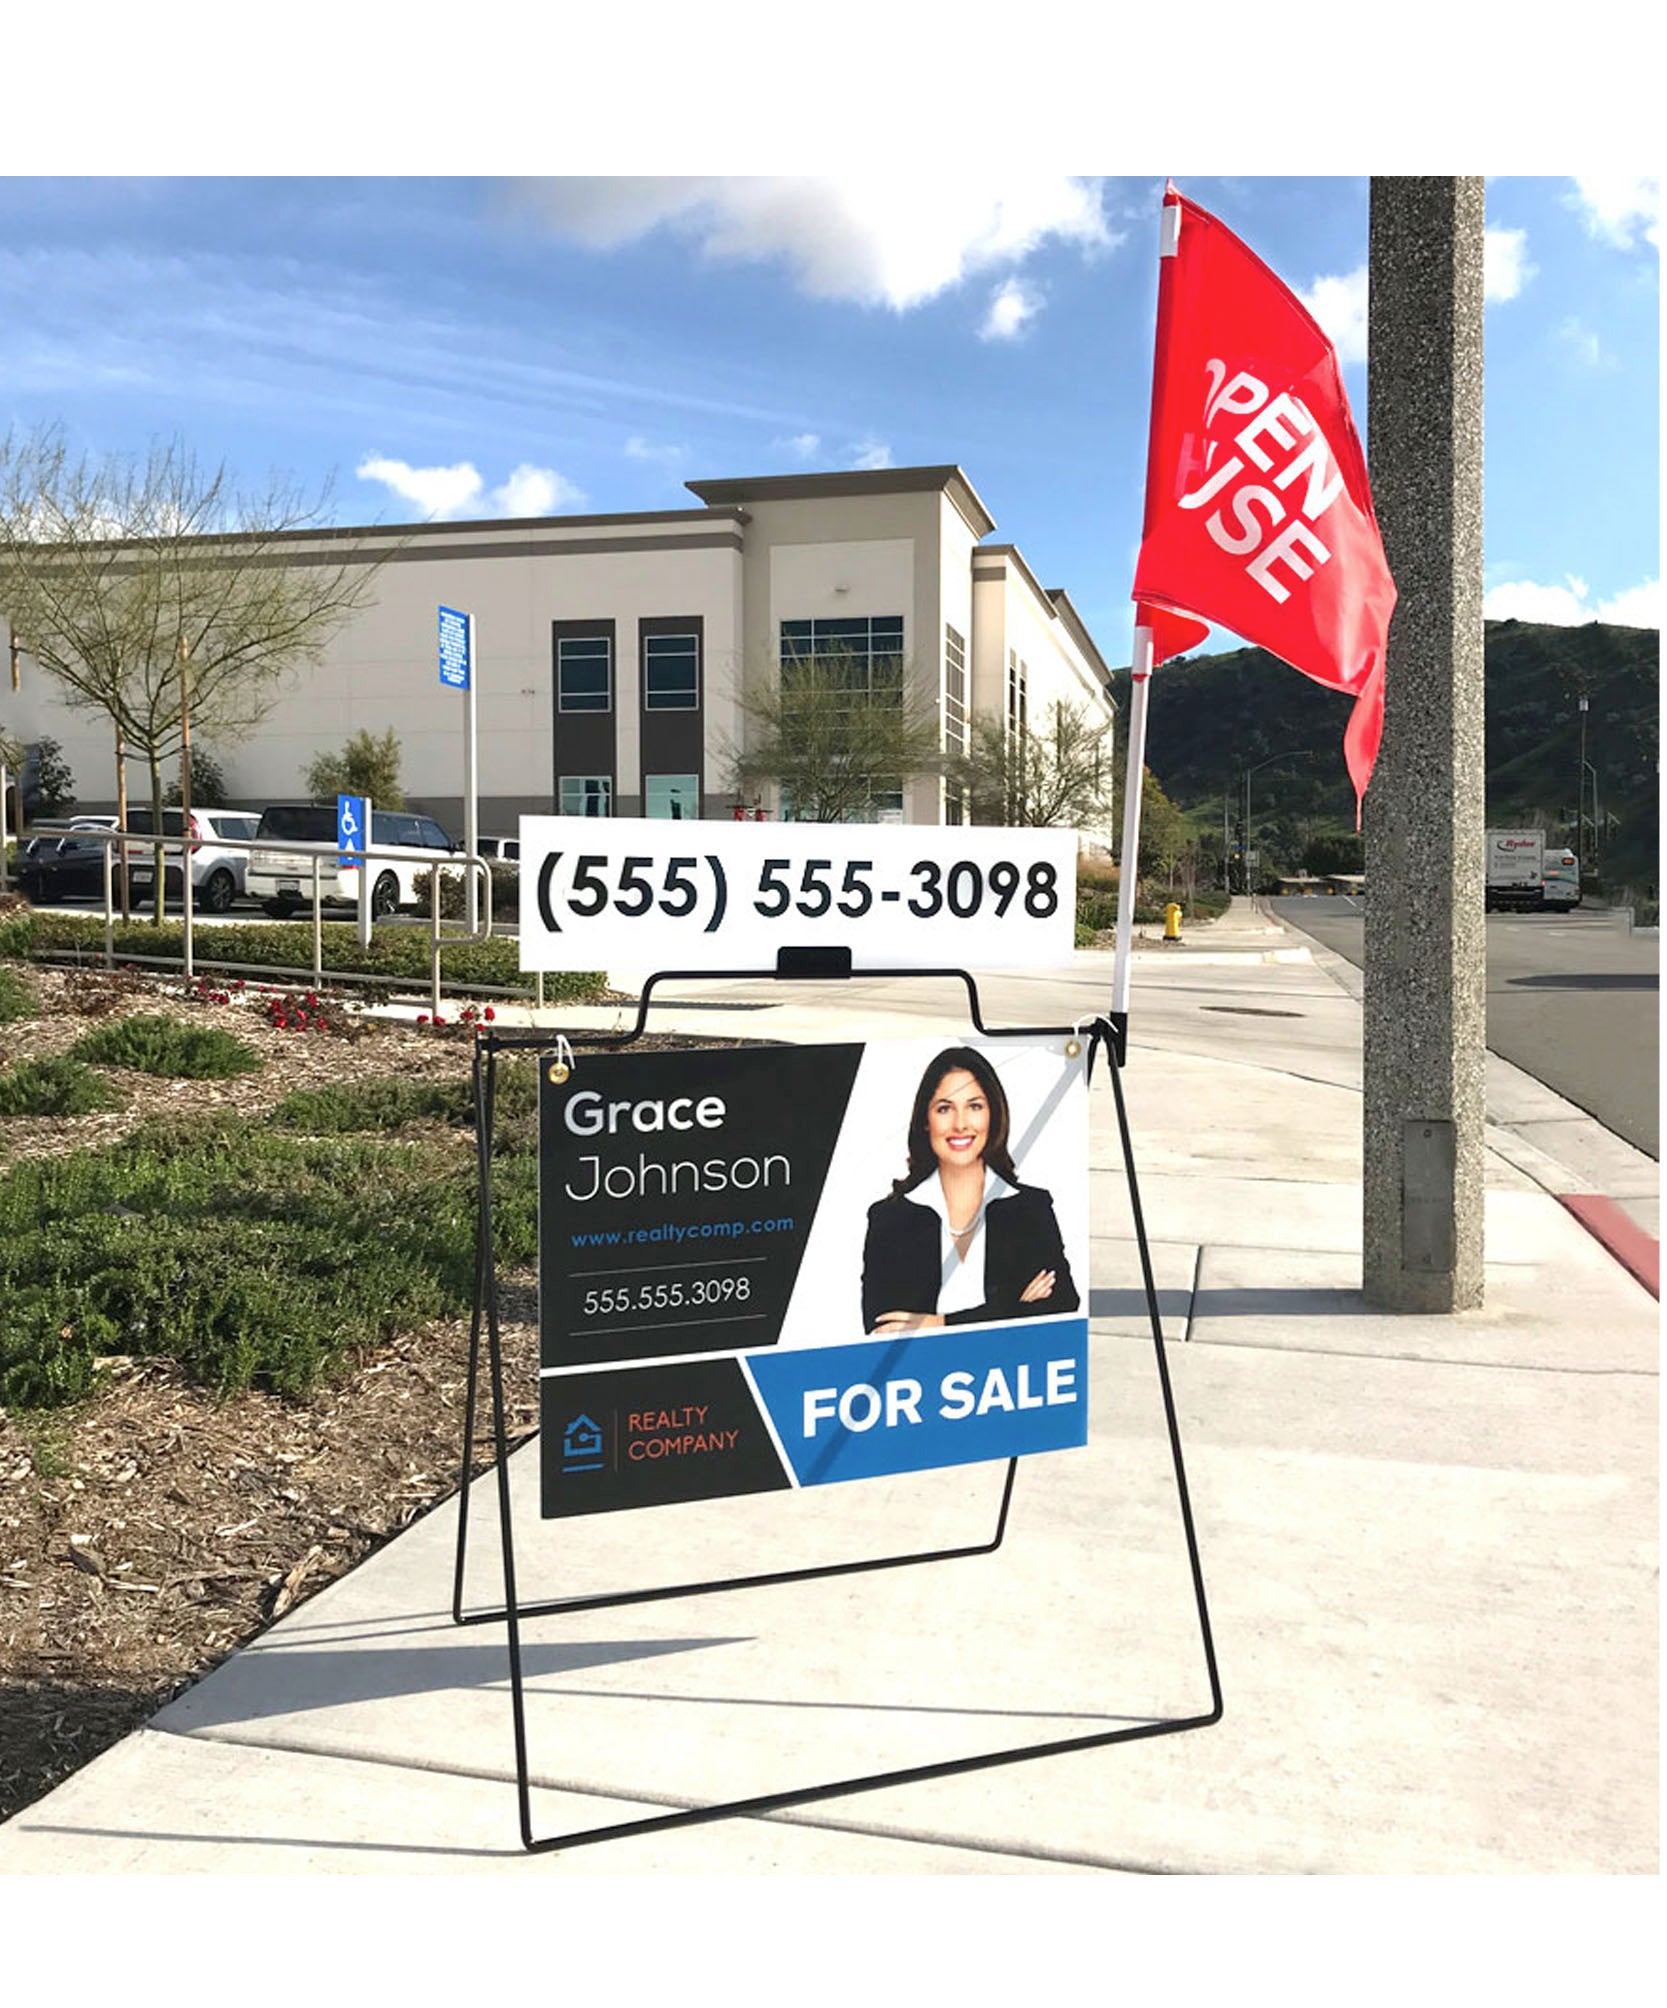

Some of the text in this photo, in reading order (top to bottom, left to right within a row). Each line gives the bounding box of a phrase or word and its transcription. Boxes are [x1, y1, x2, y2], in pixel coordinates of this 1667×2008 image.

[537, 851, 1058, 933] (555) 555-3098
[563, 1091, 726, 1136] Grace
[565, 1153, 791, 1202] Johnson
[571, 1216, 795, 1249] www.realtycomp.com
[583, 1276, 751, 1315] 555.555.3098
[628, 1405, 709, 1432] REALTY
[802, 1358, 1078, 1439] FOR SALE
[628, 1430, 739, 1462] COMPANY
